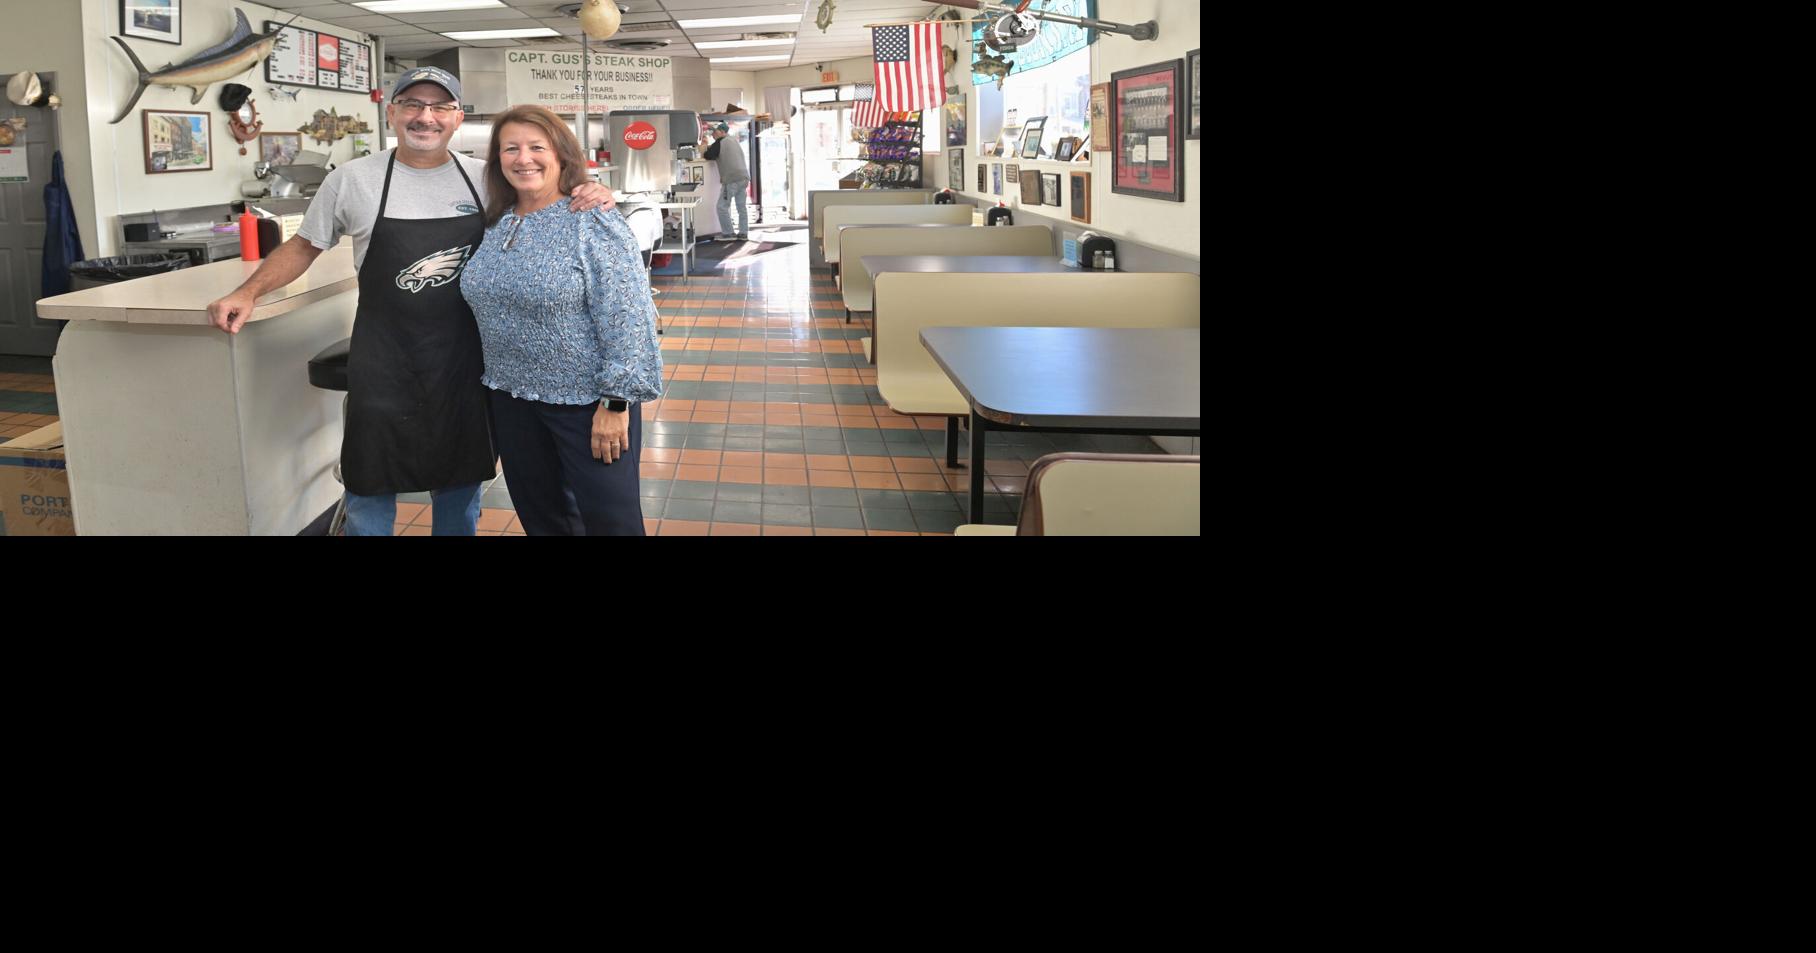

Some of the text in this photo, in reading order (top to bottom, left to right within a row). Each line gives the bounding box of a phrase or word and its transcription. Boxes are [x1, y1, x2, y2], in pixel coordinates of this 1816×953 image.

[508, 52, 548, 63] CAPT.
[594, 55, 635, 67] STEAK
[638, 57, 670, 68] SHOP
[531, 68, 653, 82] THANK YOU FOR YOUR BUSINESS!!
[574, 84, 585, 93] 57
[624, 130, 656, 140] Coca-Cola
